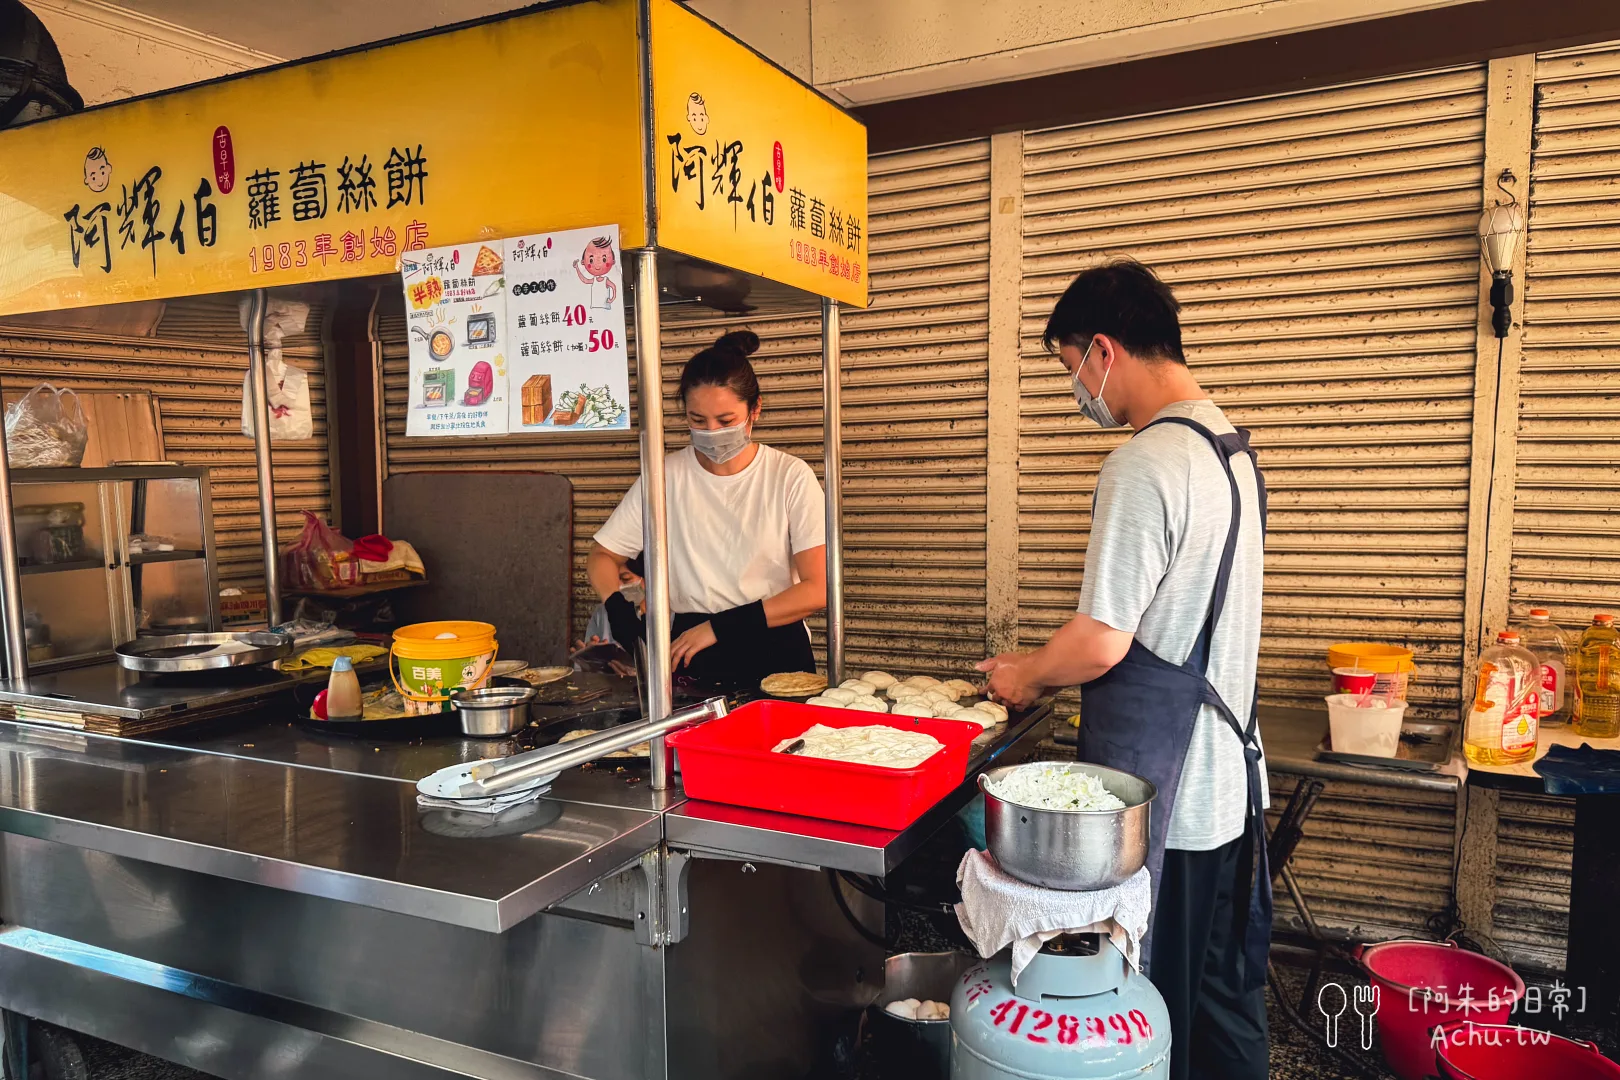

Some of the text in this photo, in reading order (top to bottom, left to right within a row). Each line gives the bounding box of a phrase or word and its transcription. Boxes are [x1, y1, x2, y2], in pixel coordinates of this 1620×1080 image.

[216, 129, 231, 190] 古早味
[667, 133, 774, 232] 阿輝伯
[245, 144, 429, 230] 蘿蔔絲餅
[64, 166, 218, 278] 阿輝伯
[789, 186, 861, 255] 蘿蔔絲餅
[249, 220, 430, 274] 1983年創始店
[422, 257, 456, 276] 阿輝伯
[512, 244, 548, 262] 阿輝伯
[789, 238, 861, 284] 1983年創始店
[413, 278, 442, 305] 半熟
[562, 304, 587, 327] 40
[588, 329, 614, 353] 50
[412, 666, 442, 681] 百美
